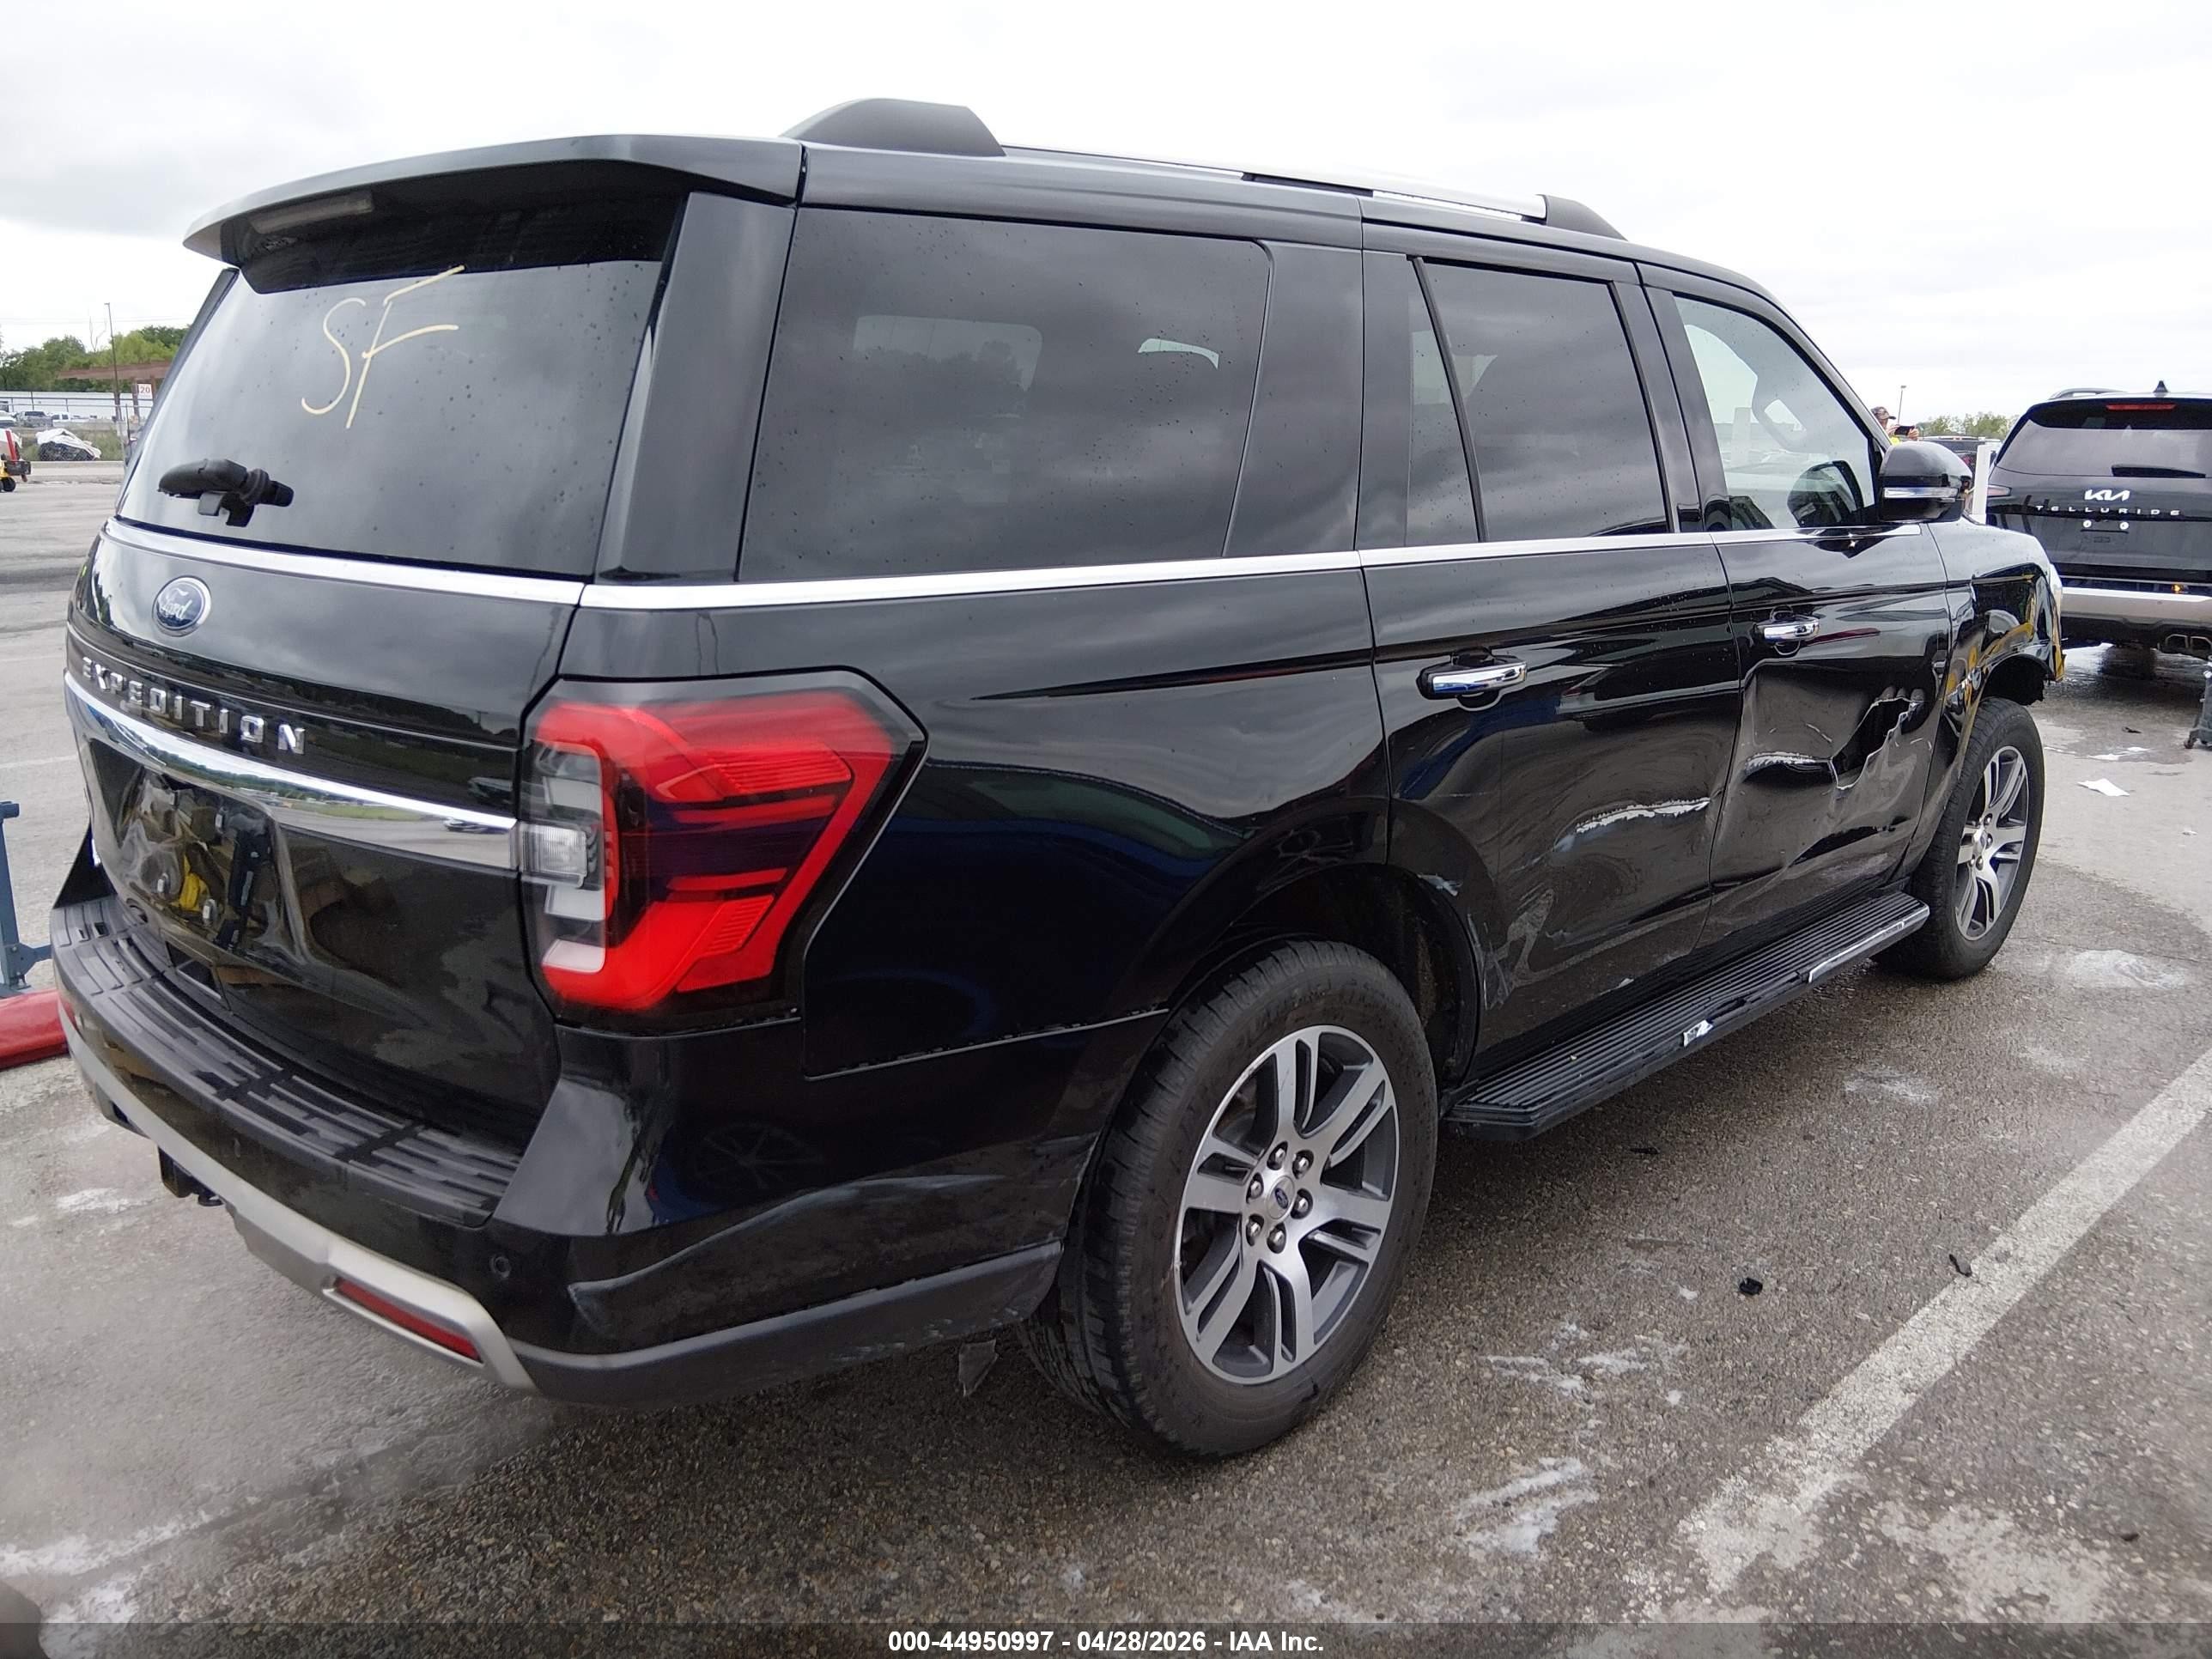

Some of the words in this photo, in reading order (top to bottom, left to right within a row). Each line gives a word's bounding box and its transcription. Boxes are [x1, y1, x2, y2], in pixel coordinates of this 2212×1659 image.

[301, 264, 465, 429] SF
[2036, 505, 2181, 516] TELLURIDE
[160, 587, 193, 621] Ford
[82, 657, 307, 755] EXPEDITION
